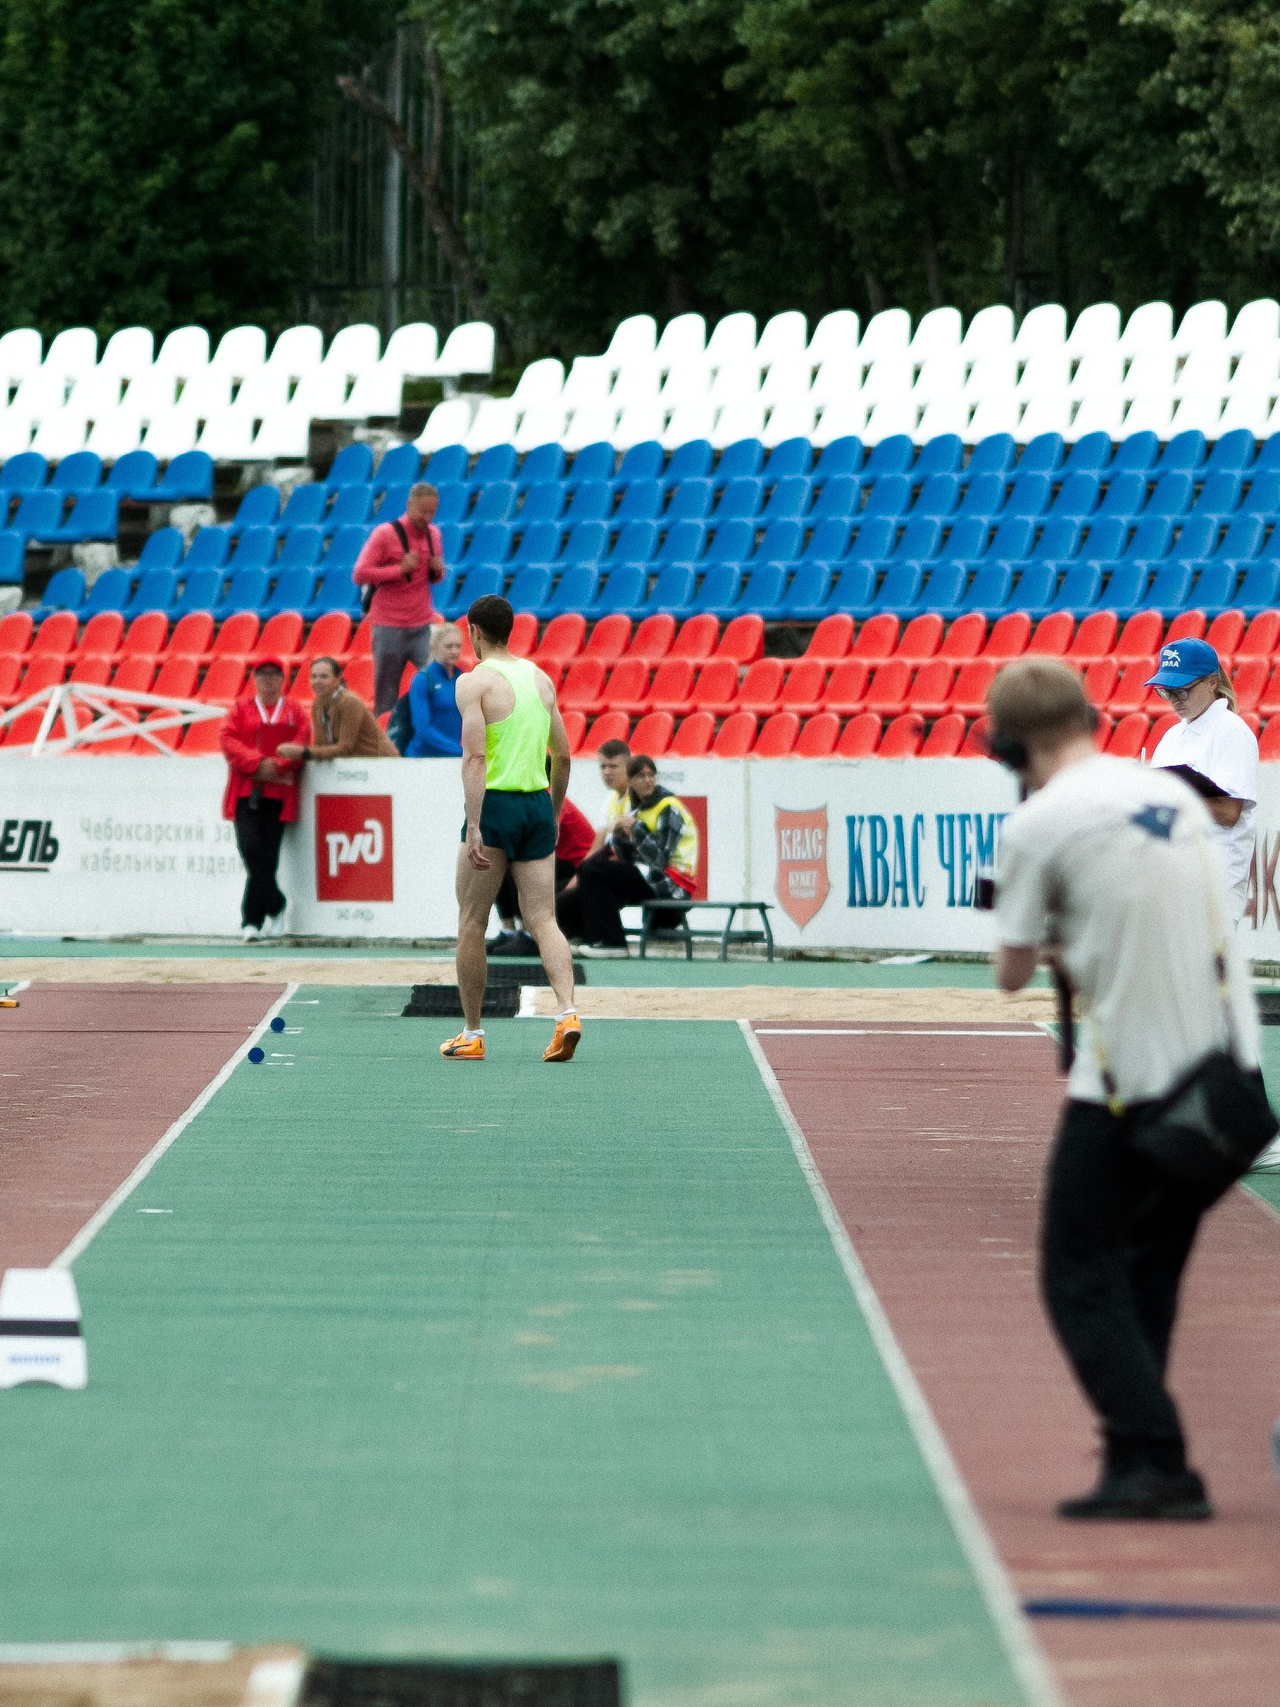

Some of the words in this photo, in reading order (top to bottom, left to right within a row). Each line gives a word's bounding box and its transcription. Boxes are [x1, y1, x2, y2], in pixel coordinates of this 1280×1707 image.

[81, 817, 204, 844] Чебоксарский
[214, 824, 232, 843] за
[781, 827, 824, 860] КВАС
[81, 848, 175, 873] кабельных
[845, 813, 928, 908] КВАС
